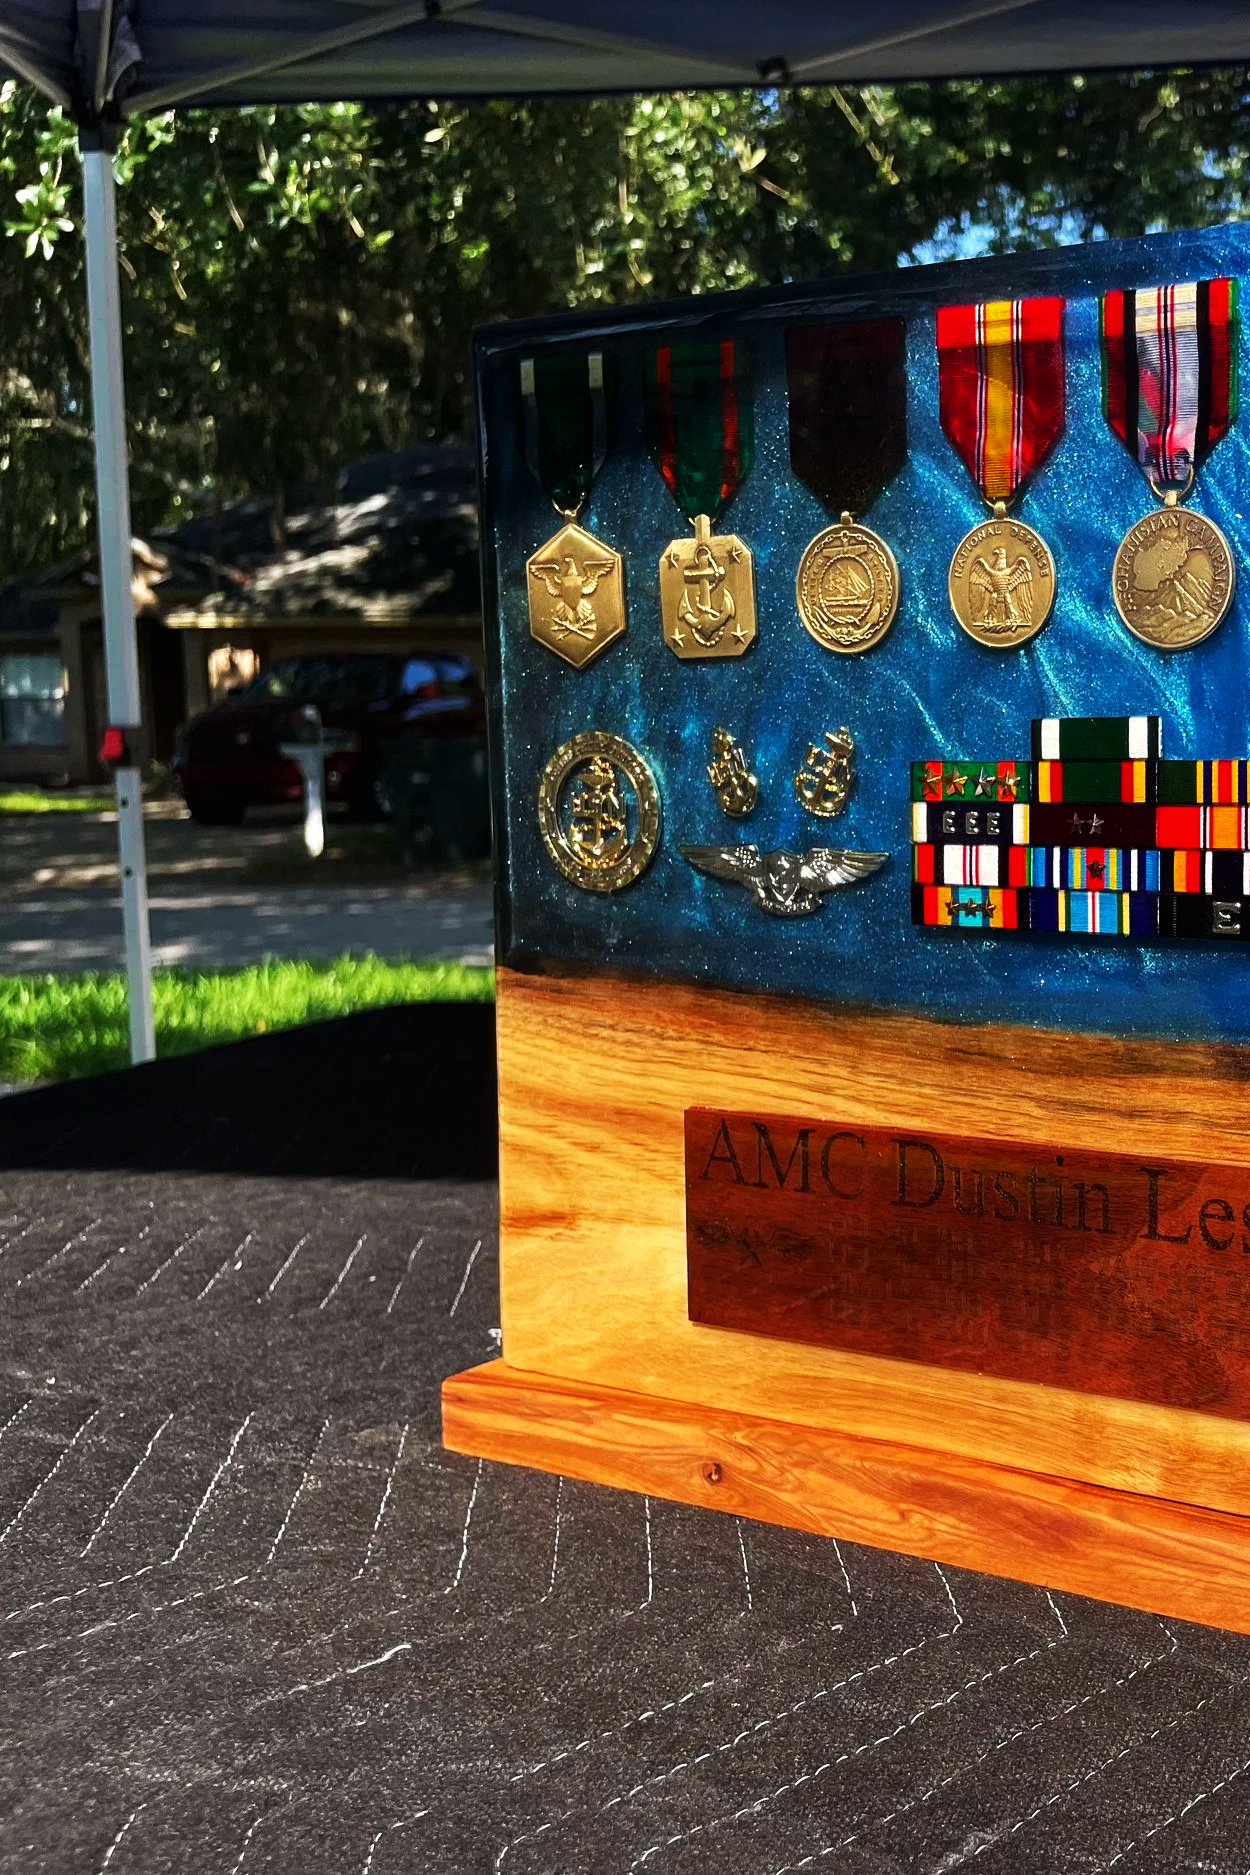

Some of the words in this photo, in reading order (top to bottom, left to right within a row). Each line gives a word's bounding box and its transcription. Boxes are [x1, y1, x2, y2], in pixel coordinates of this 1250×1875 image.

[953, 526, 1002, 579] NATIONAL
[1009, 526, 1050, 578] DEFENSE
[942, 810, 956, 835] E
[965, 811, 979, 835] E
[986, 811, 1001, 835] E
[1212, 901, 1242, 935] E
[701, 1117, 868, 1200] AMC
[891, 1137, 1116, 1235] Dustin
